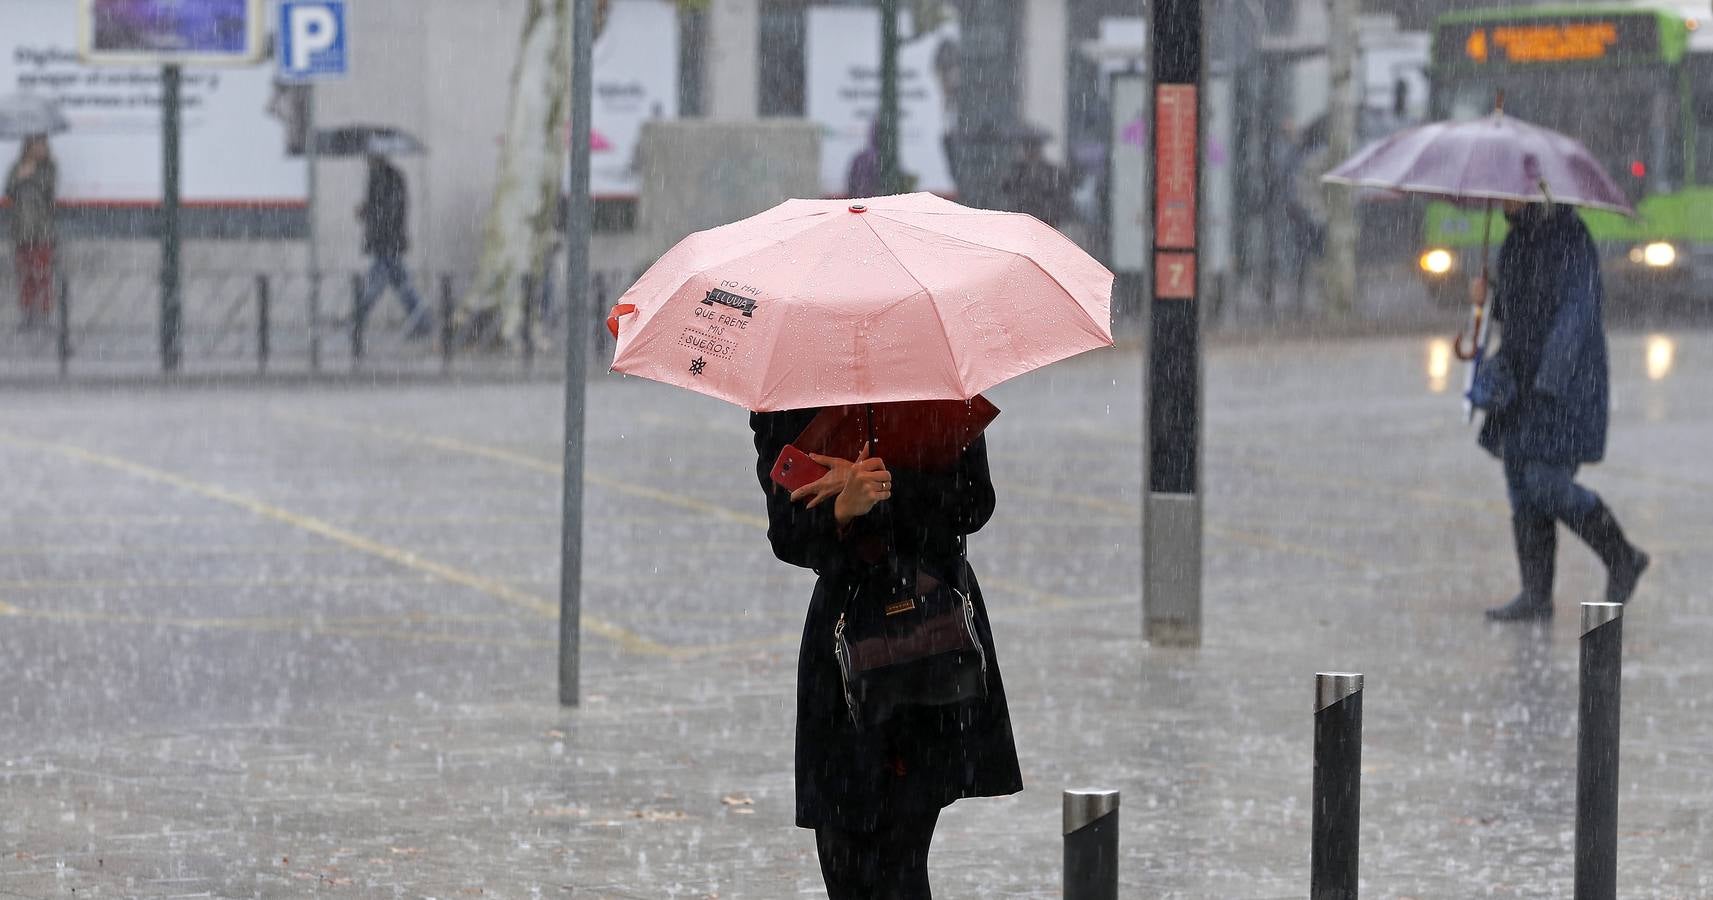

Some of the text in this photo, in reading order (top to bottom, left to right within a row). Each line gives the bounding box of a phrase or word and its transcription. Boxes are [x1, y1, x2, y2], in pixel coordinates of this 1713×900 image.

[290, 6, 338, 70] P
[1168, 263, 1185, 288] 7
[720, 279, 762, 297] NO HAY
[716, 292, 747, 308] LLUVIA
[694, 306, 749, 330] QUE FRENE
[707, 324, 725, 336] MIS
[685, 335, 730, 355] SUEÑOS
